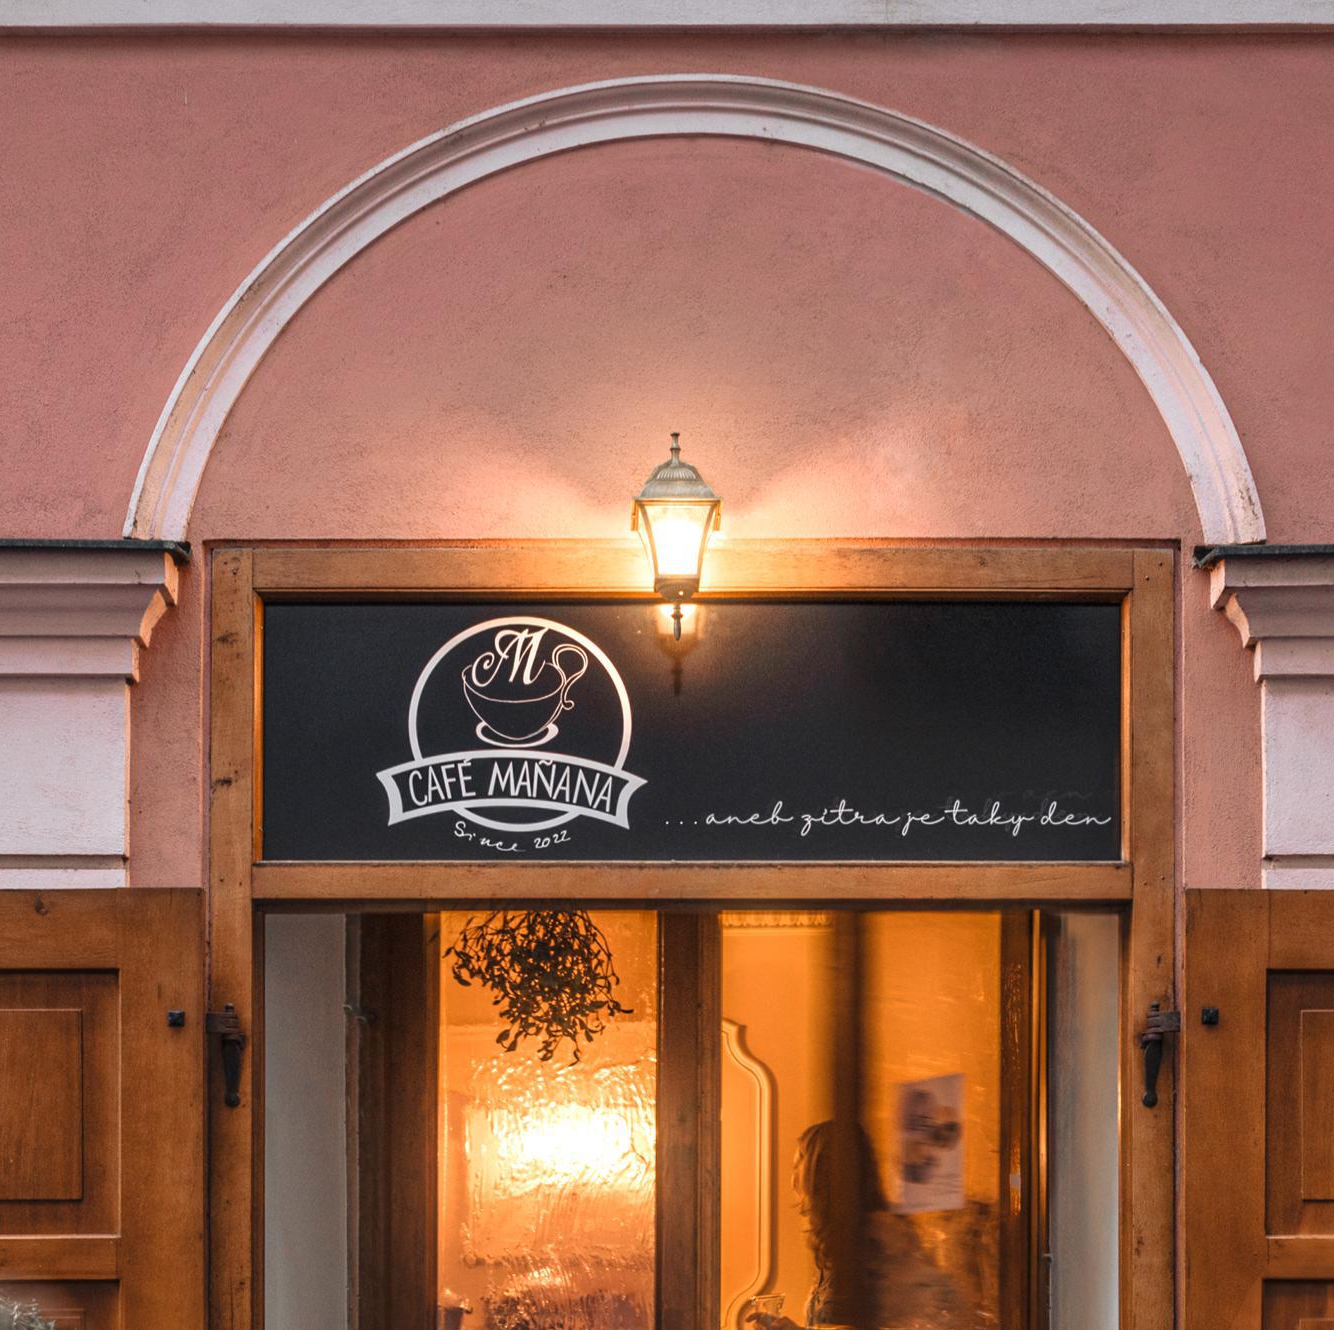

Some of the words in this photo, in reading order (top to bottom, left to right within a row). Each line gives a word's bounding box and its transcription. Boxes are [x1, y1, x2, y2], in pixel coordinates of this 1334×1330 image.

[471, 627, 549, 687] M
[408, 759, 476, 807] CAFÉ
[487, 759, 613, 813] MAÑANA
[453, 820, 526, 852] Since
[533, 829, 572, 849] 2022
[901, 811, 945, 837] je
[944, 799, 1035, 837] taky
[1039, 800, 1112, 826] den
